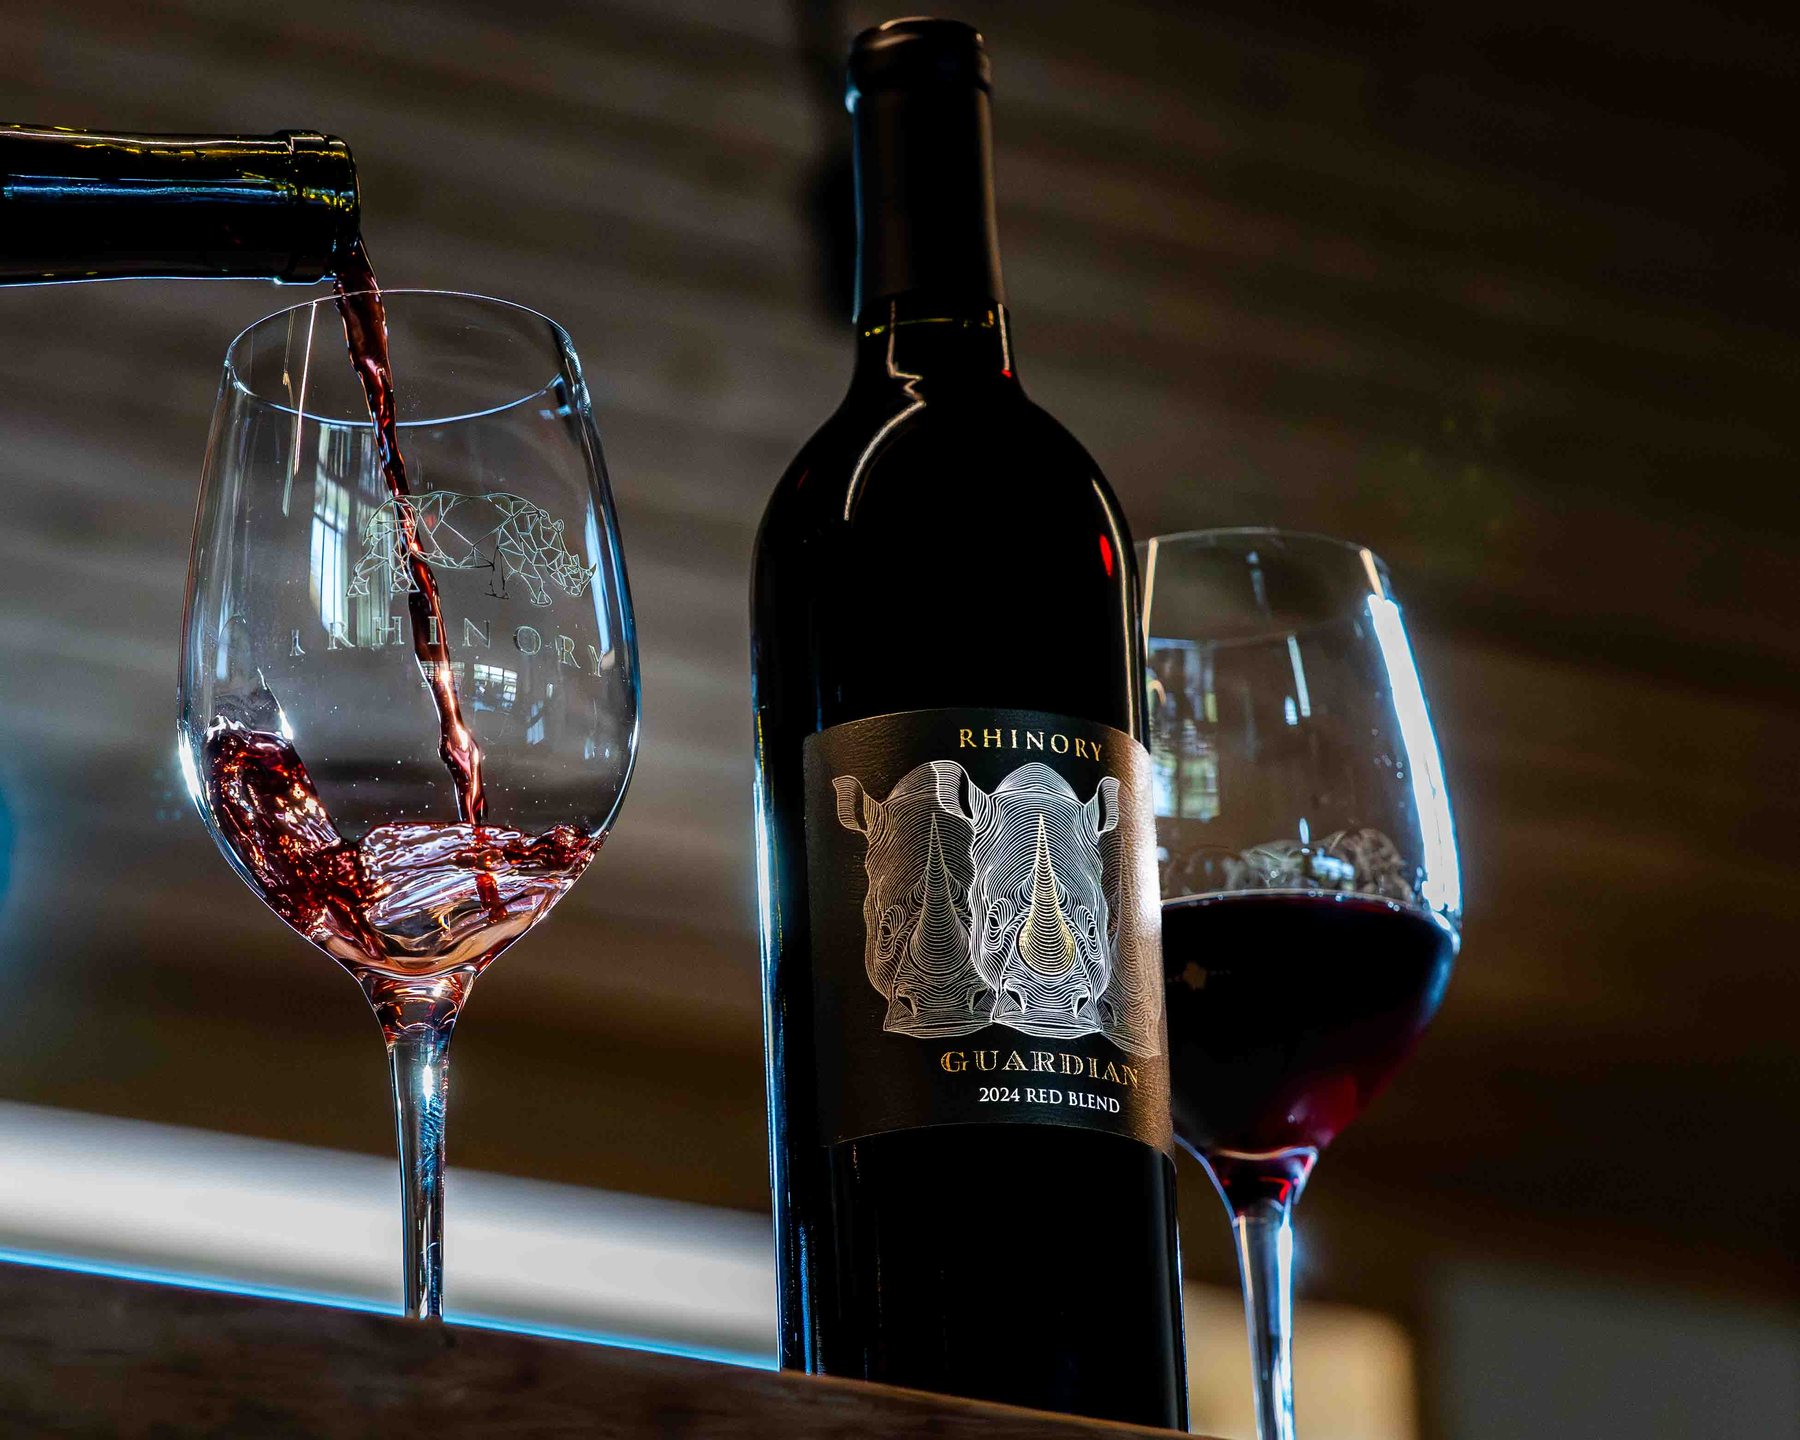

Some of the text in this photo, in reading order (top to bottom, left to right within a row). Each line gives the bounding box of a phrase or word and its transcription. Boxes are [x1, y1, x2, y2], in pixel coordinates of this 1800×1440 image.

[327, 616, 606, 677] RHINORY
[959, 728, 1102, 762] RHINORY
[940, 1050, 1138, 1089] GUARDIAN
[979, 1087, 1120, 1114] 2024 RED BLEND
